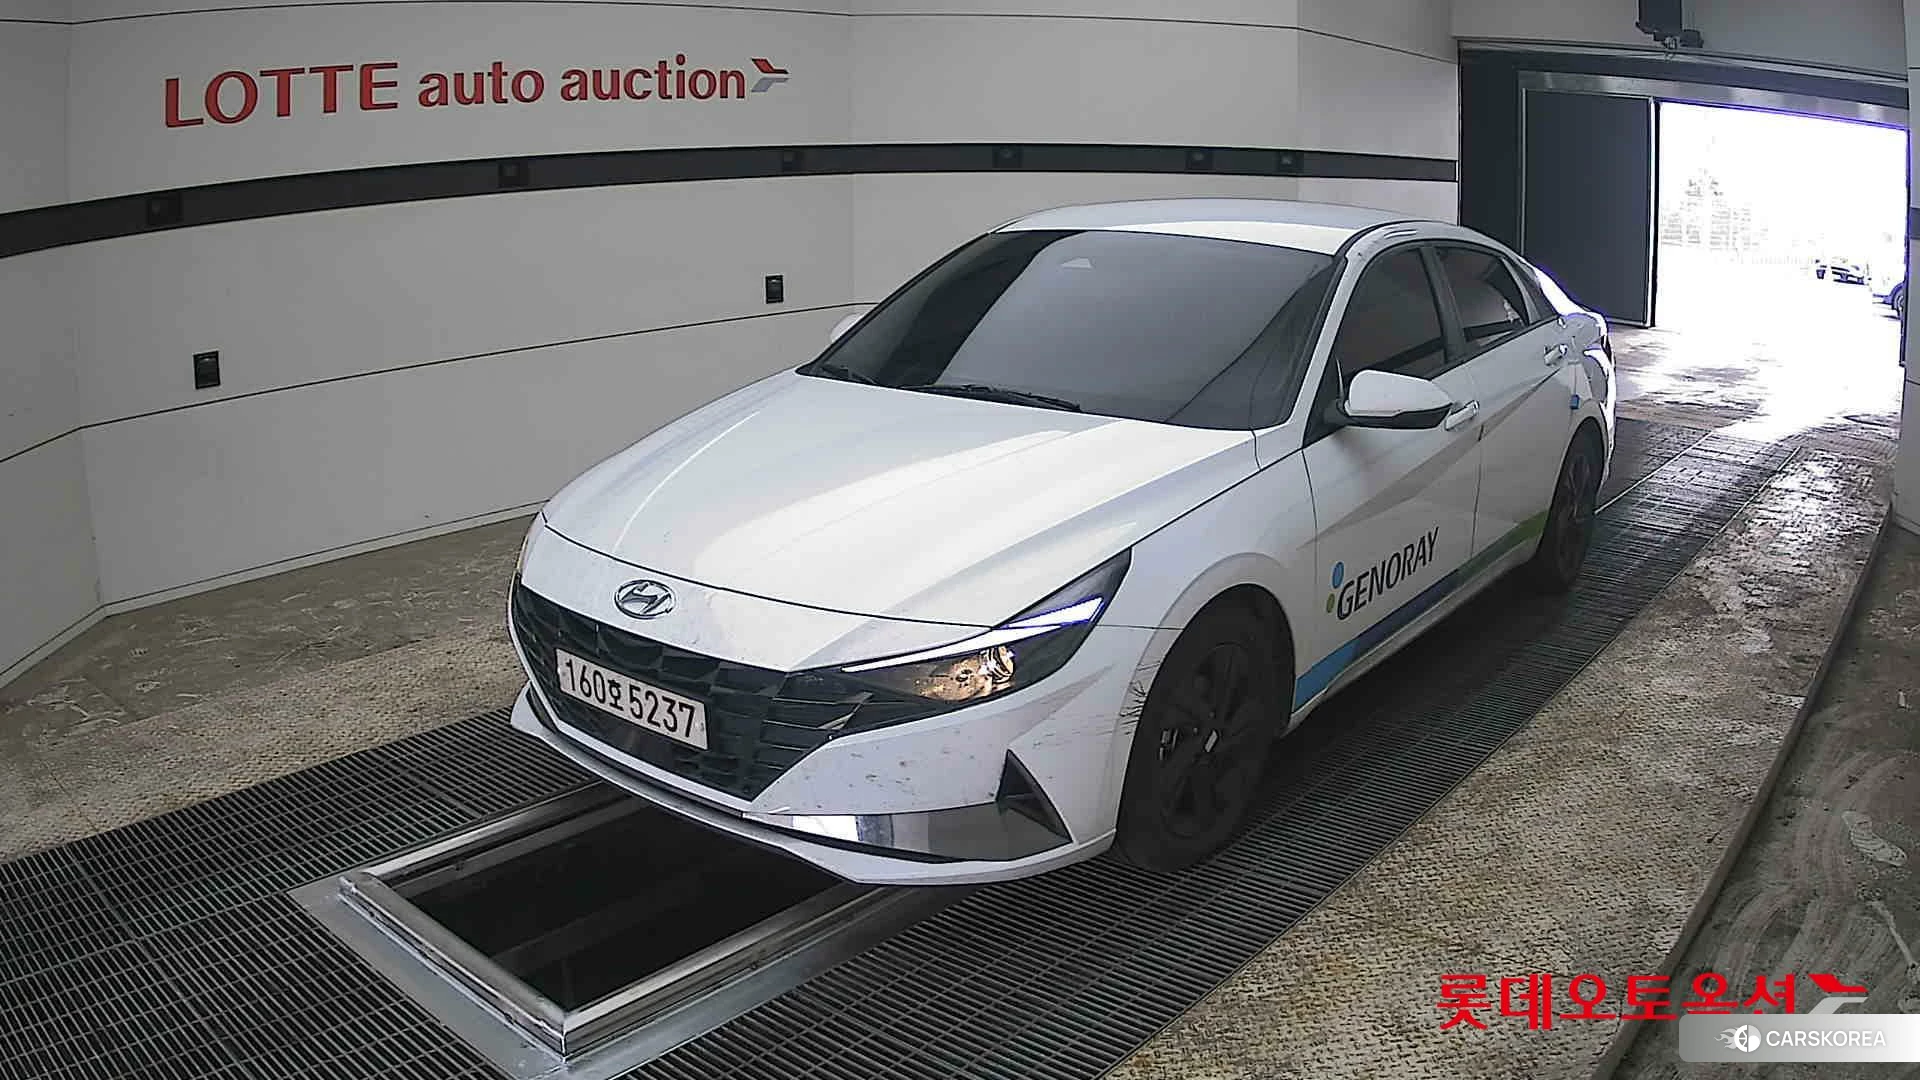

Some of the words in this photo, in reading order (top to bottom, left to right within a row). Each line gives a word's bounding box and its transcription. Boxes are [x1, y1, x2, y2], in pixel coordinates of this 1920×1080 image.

[165, 62, 398, 128] LOTTE
[417, 61, 545, 107] auto
[560, 54, 746, 101] auction
[1336, 525, 1440, 620] GENORAY
